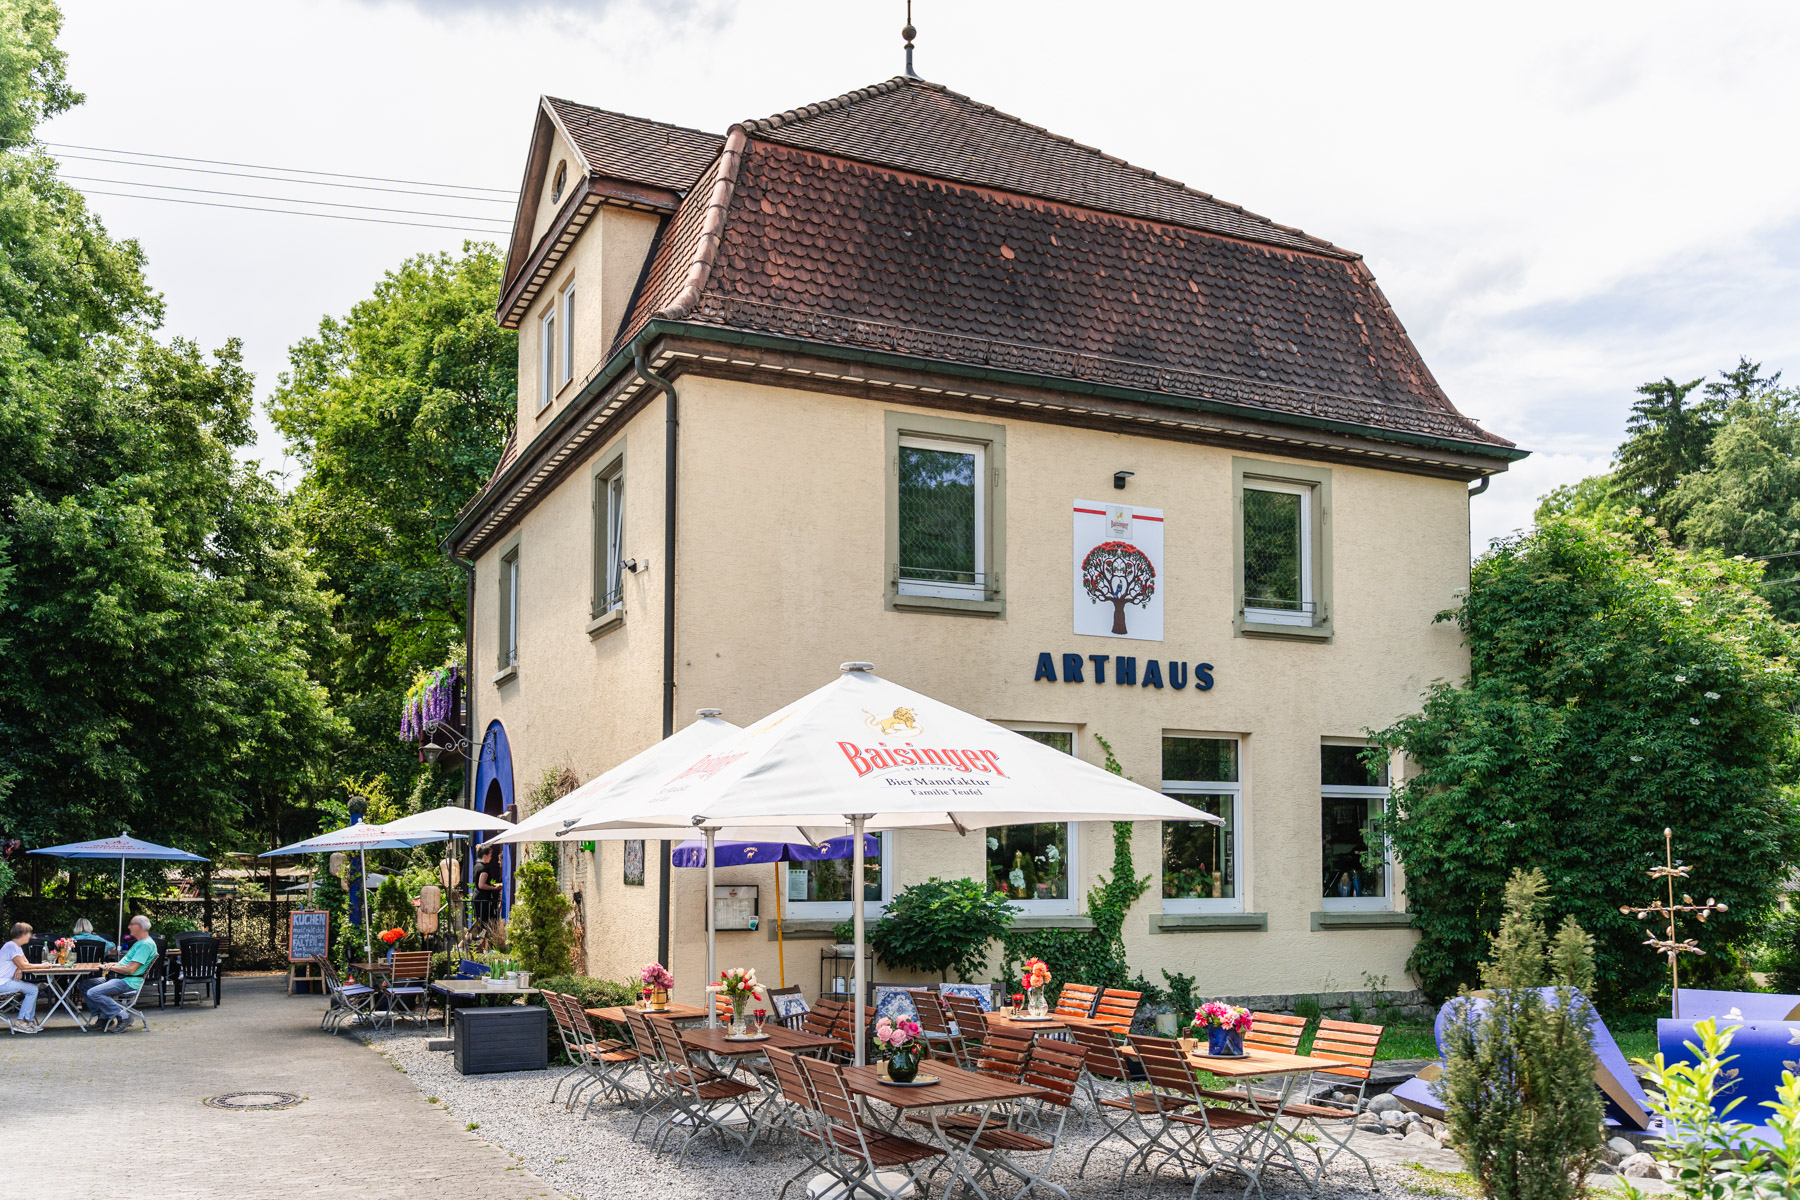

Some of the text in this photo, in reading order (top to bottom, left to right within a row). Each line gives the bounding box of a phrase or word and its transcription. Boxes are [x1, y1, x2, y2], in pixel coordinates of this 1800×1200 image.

[1034, 652, 1215, 691] ARTHAUS
[835, 741, 1010, 779] Baisinger
[885, 777, 991, 787] Bier Manufaktur
[910, 788, 983, 797] Familie Teufel
[293, 914, 326, 925] KUCHEN
